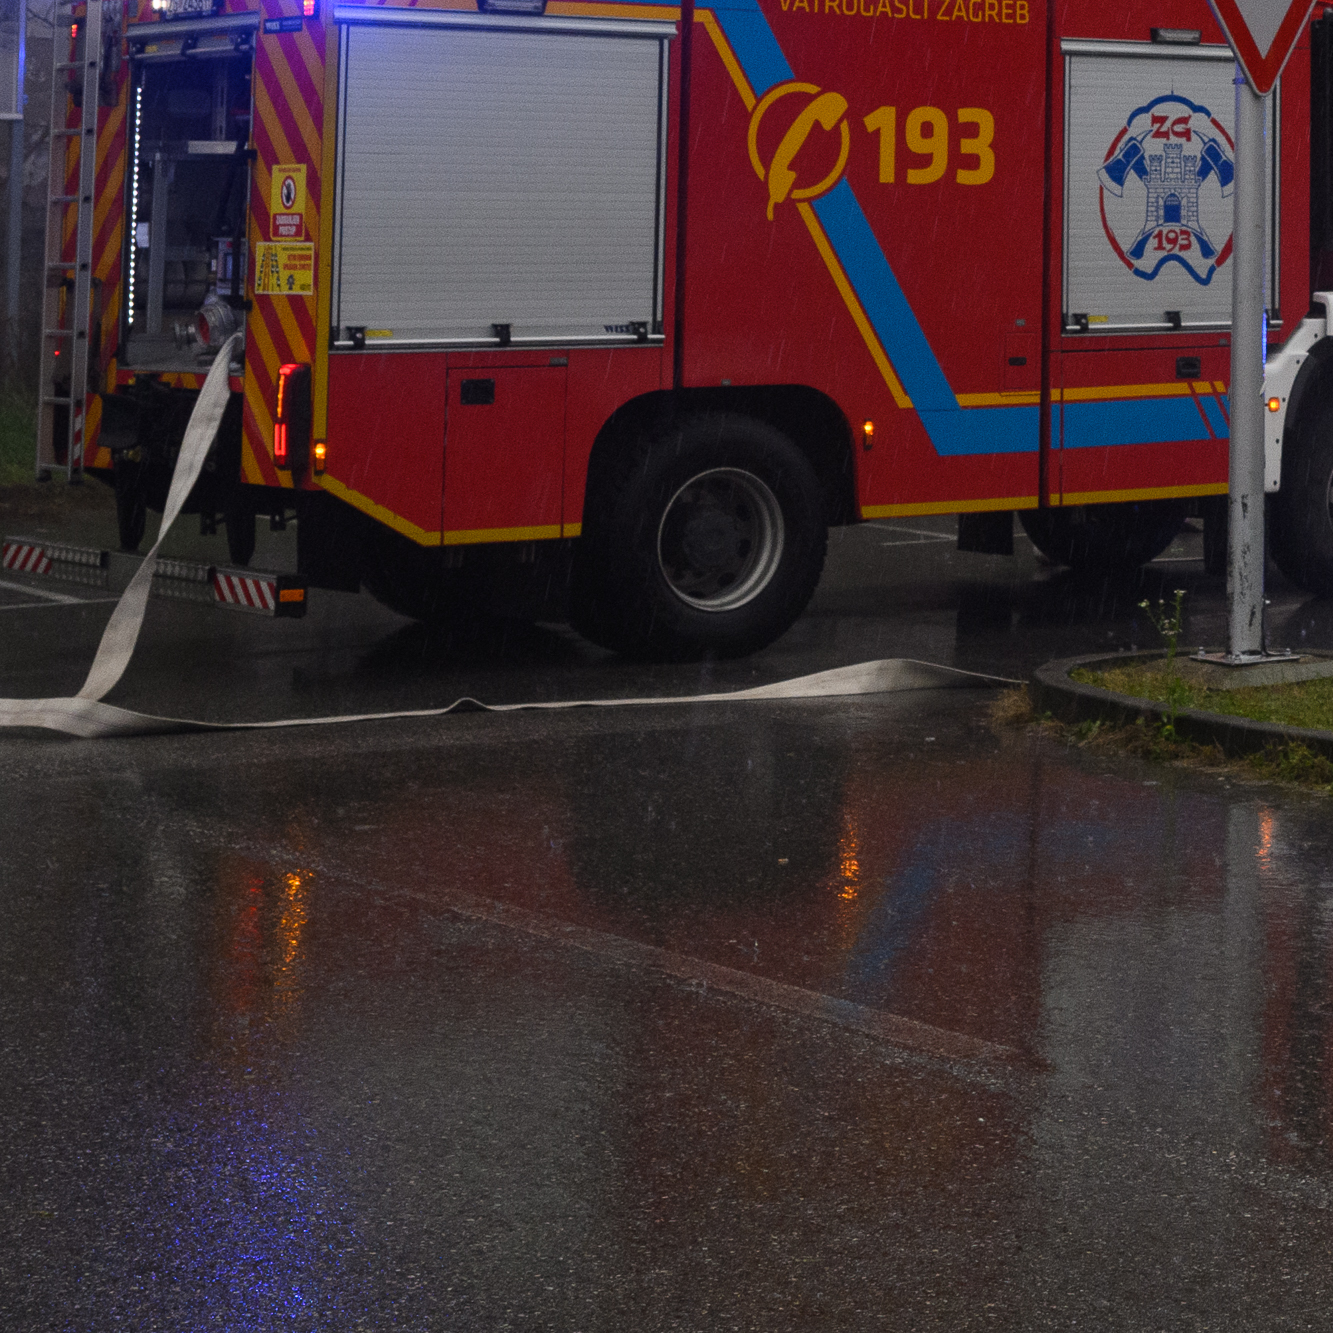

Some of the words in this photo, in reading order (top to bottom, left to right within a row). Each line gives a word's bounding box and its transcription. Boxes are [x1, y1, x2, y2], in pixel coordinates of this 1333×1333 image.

[1150, 114, 1192, 143] ZG
[862, 105, 996, 185] 193
[1152, 229, 1192, 253] 193
